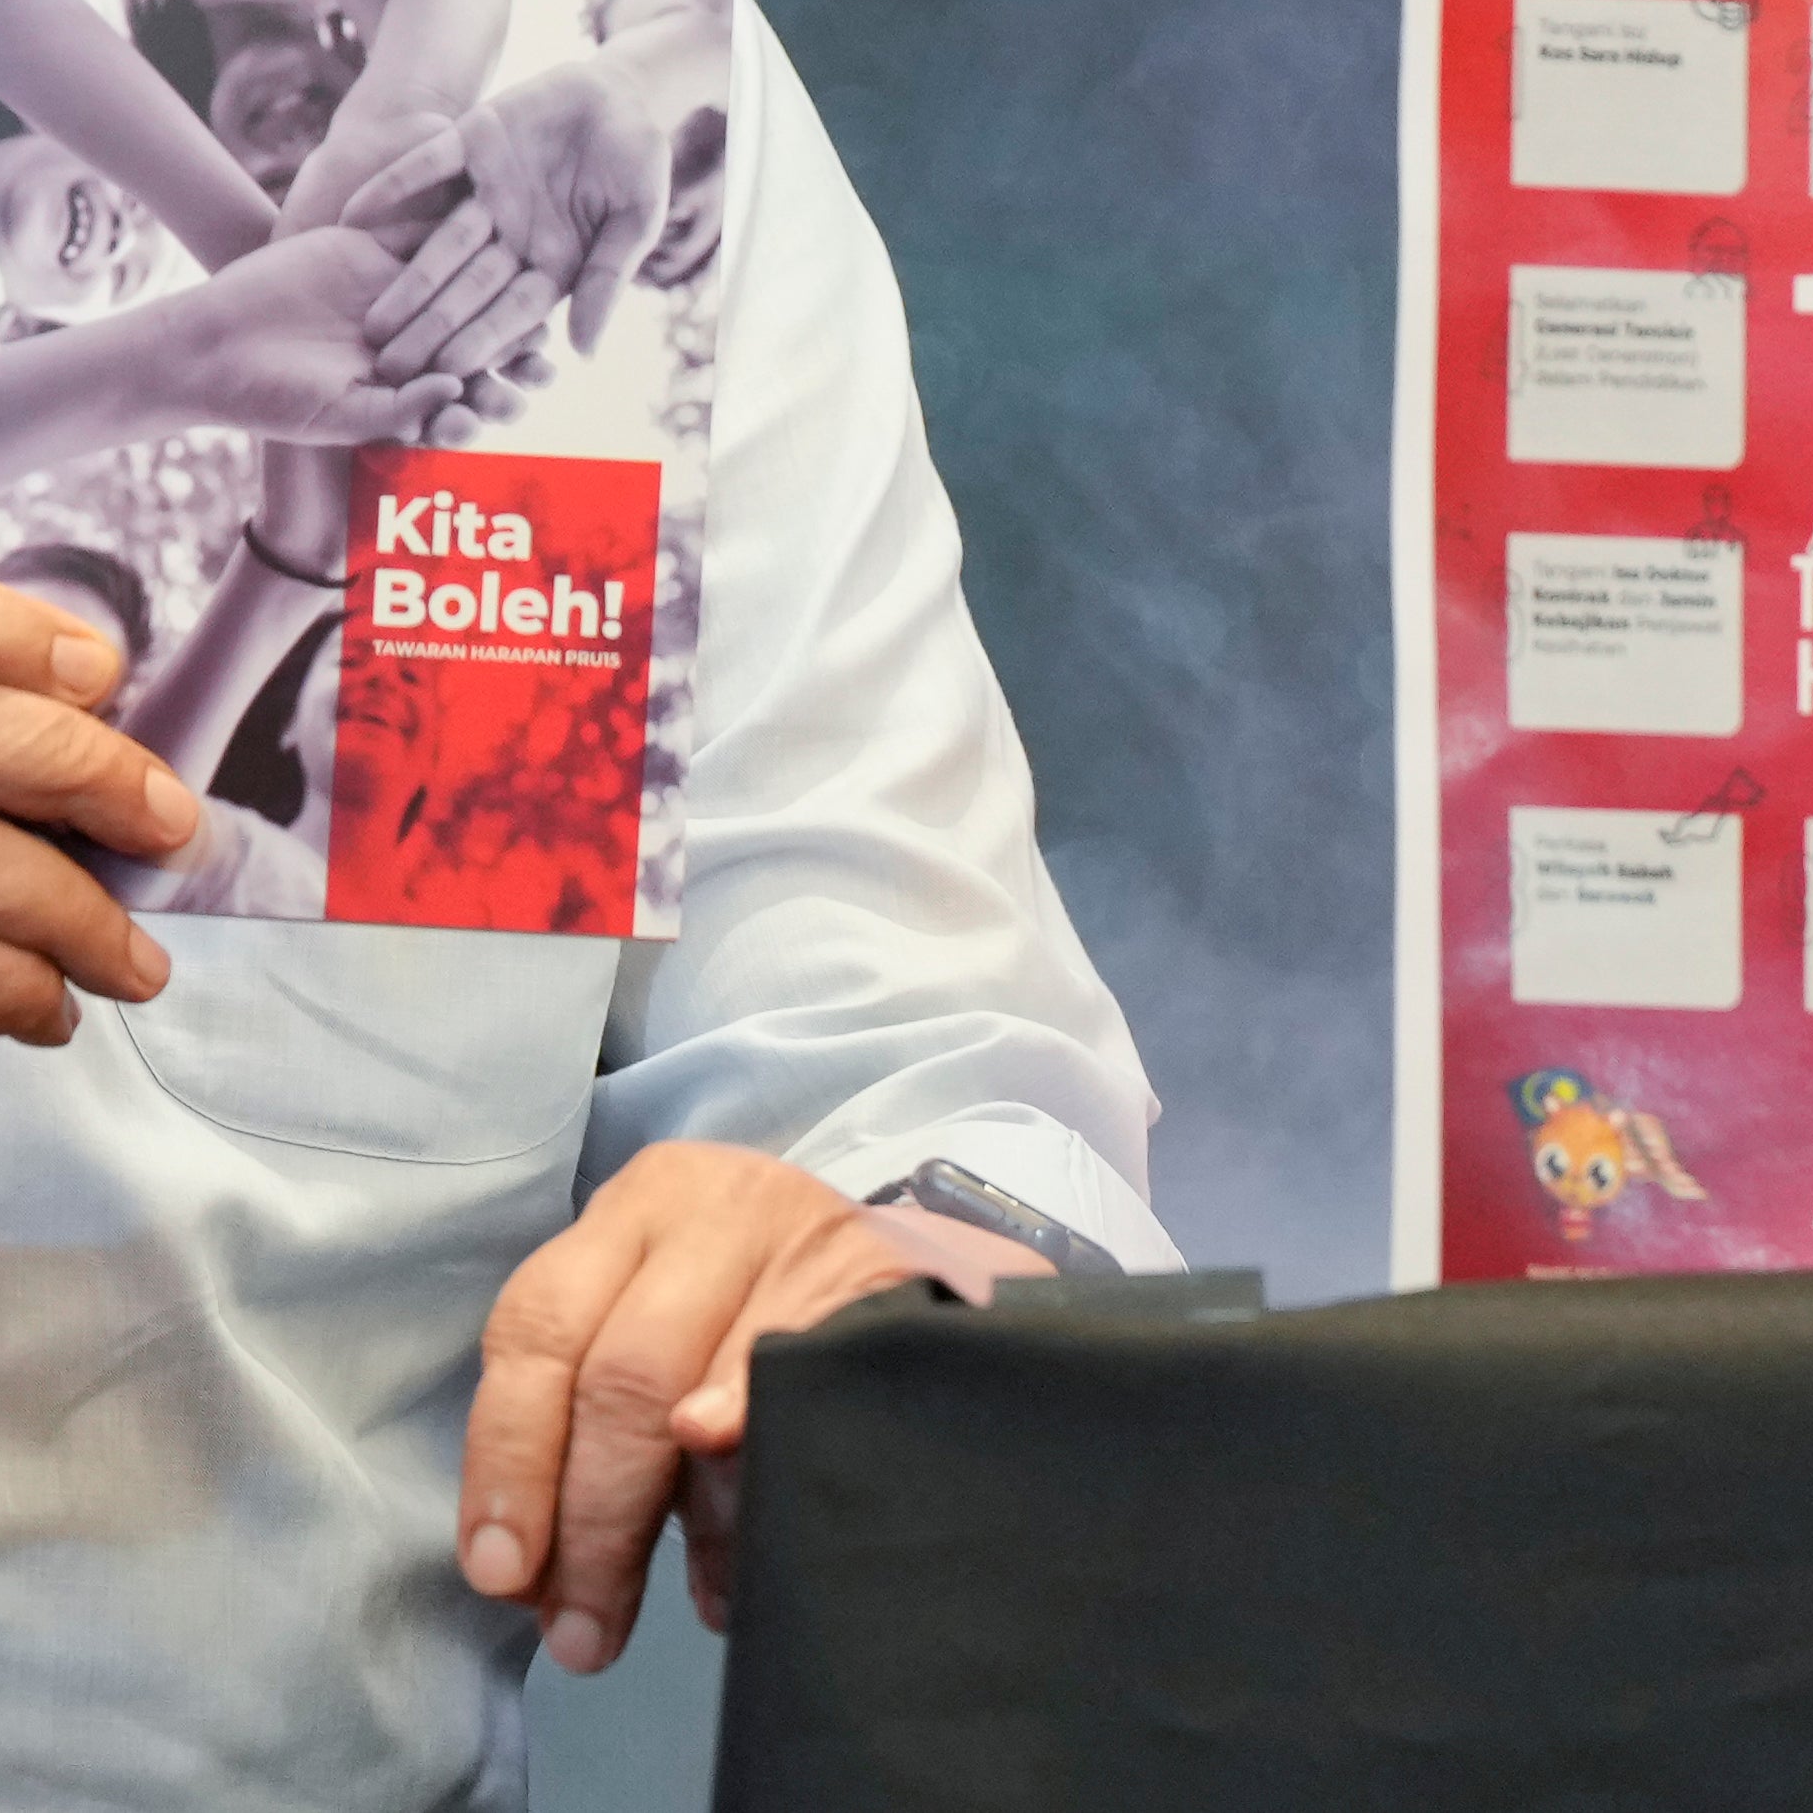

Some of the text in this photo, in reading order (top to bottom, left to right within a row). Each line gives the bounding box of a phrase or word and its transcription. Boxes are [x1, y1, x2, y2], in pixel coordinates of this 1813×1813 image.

[376, 490, 533, 561] Kita
[372, 567, 625, 640] Boleh!
[372, 639, 622, 670] TAWARAN HARAPAN PRU15
